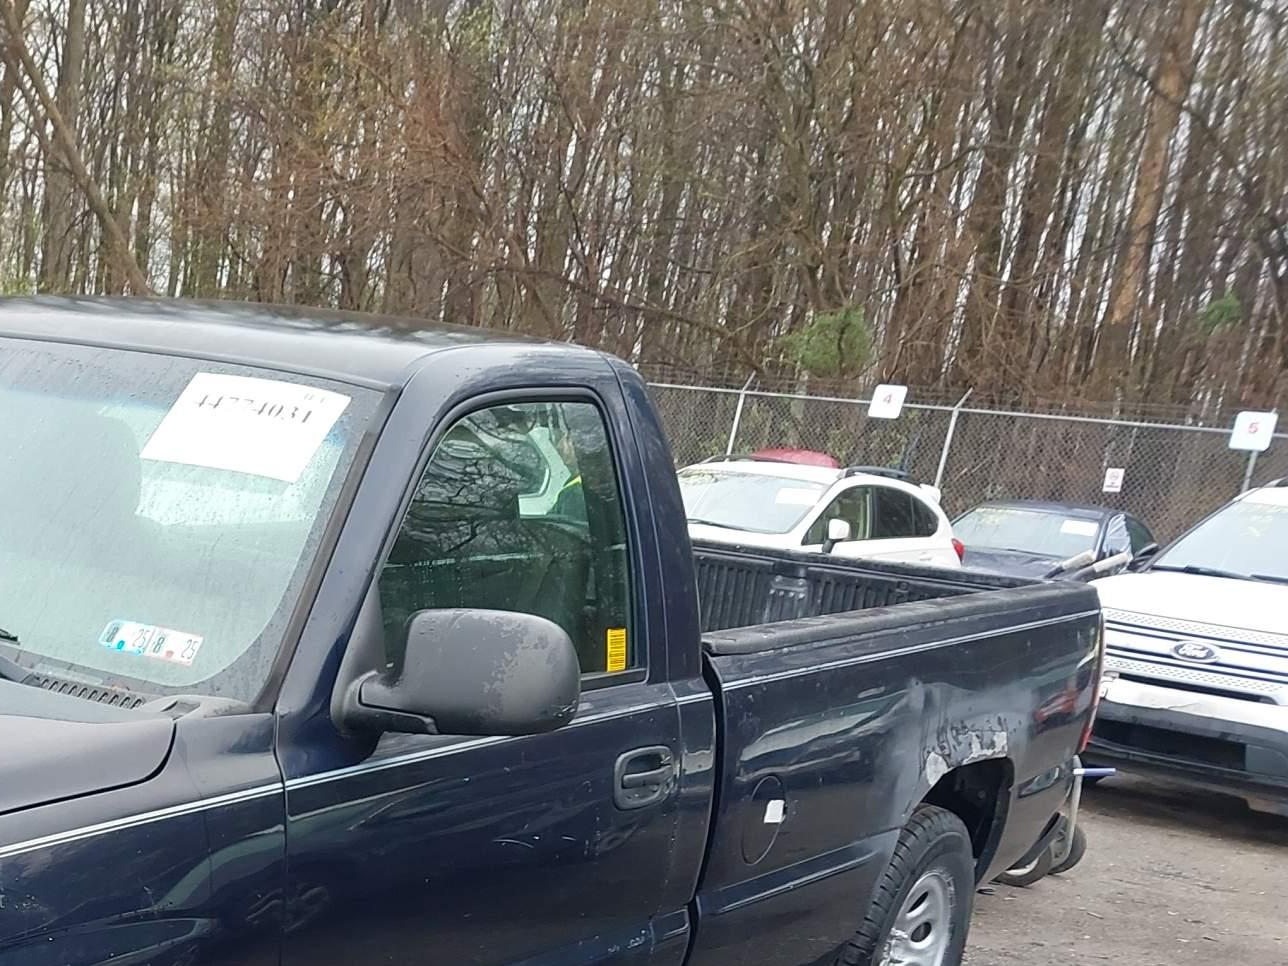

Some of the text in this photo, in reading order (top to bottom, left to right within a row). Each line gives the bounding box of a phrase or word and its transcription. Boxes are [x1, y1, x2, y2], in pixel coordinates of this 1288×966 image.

[882, 393, 893, 405] 4
[181, 639, 198, 659] 25
[1176, 642, 1212, 660] Ford
